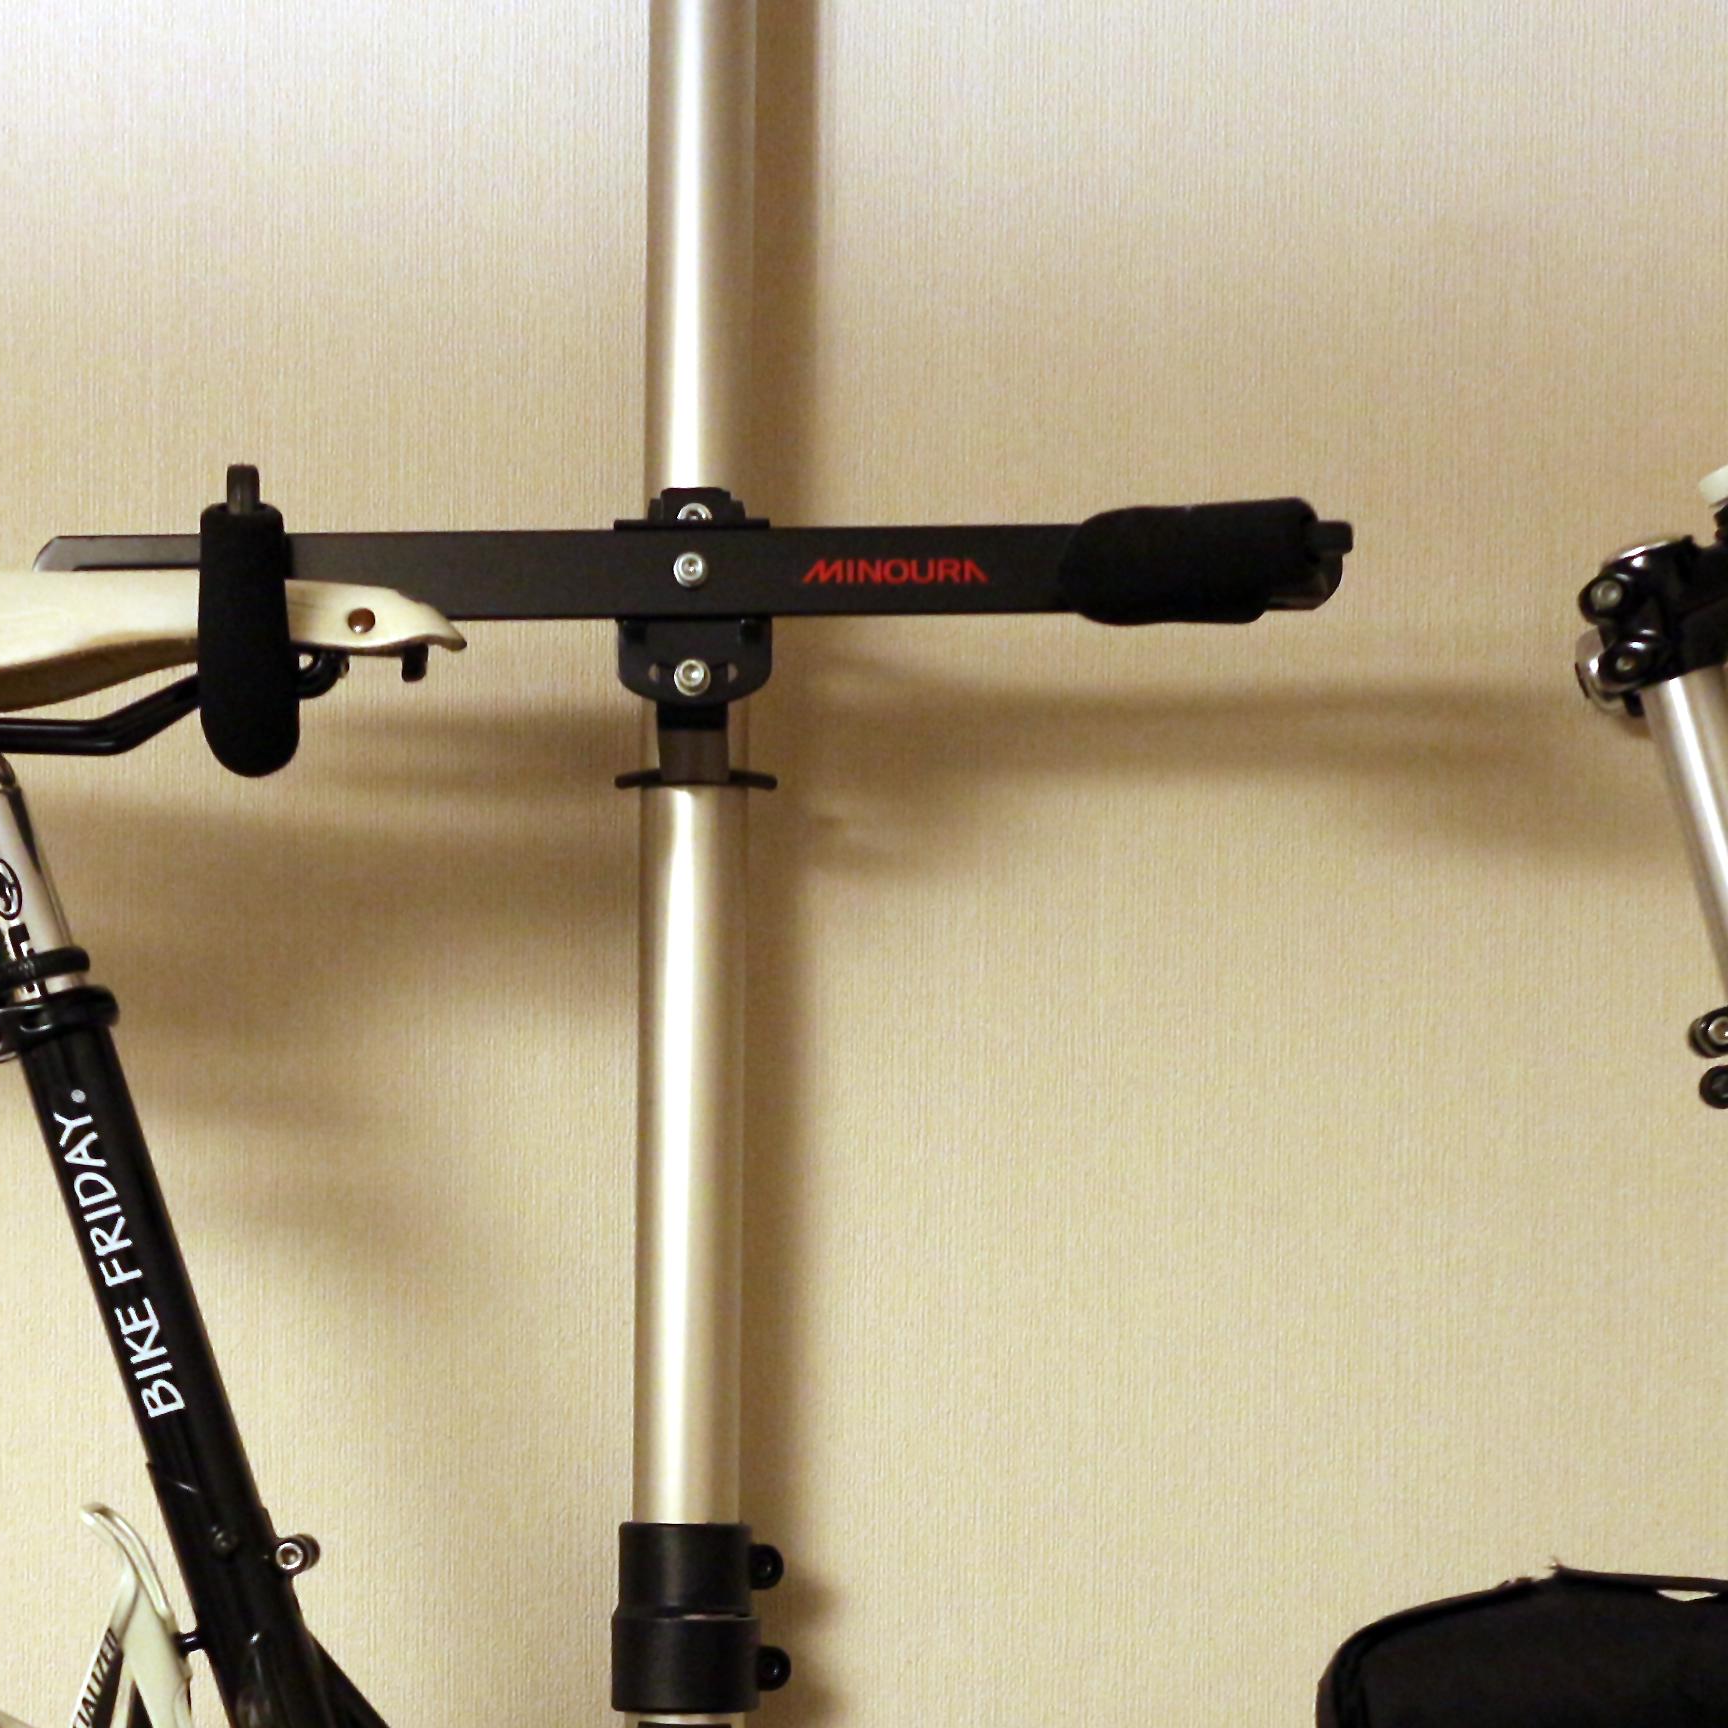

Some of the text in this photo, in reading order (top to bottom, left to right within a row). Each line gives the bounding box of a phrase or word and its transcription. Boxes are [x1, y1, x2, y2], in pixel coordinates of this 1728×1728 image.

[803, 559, 988, 584] MINOURA
[53, 1108, 186, 1419] BIKE FRIDAY
